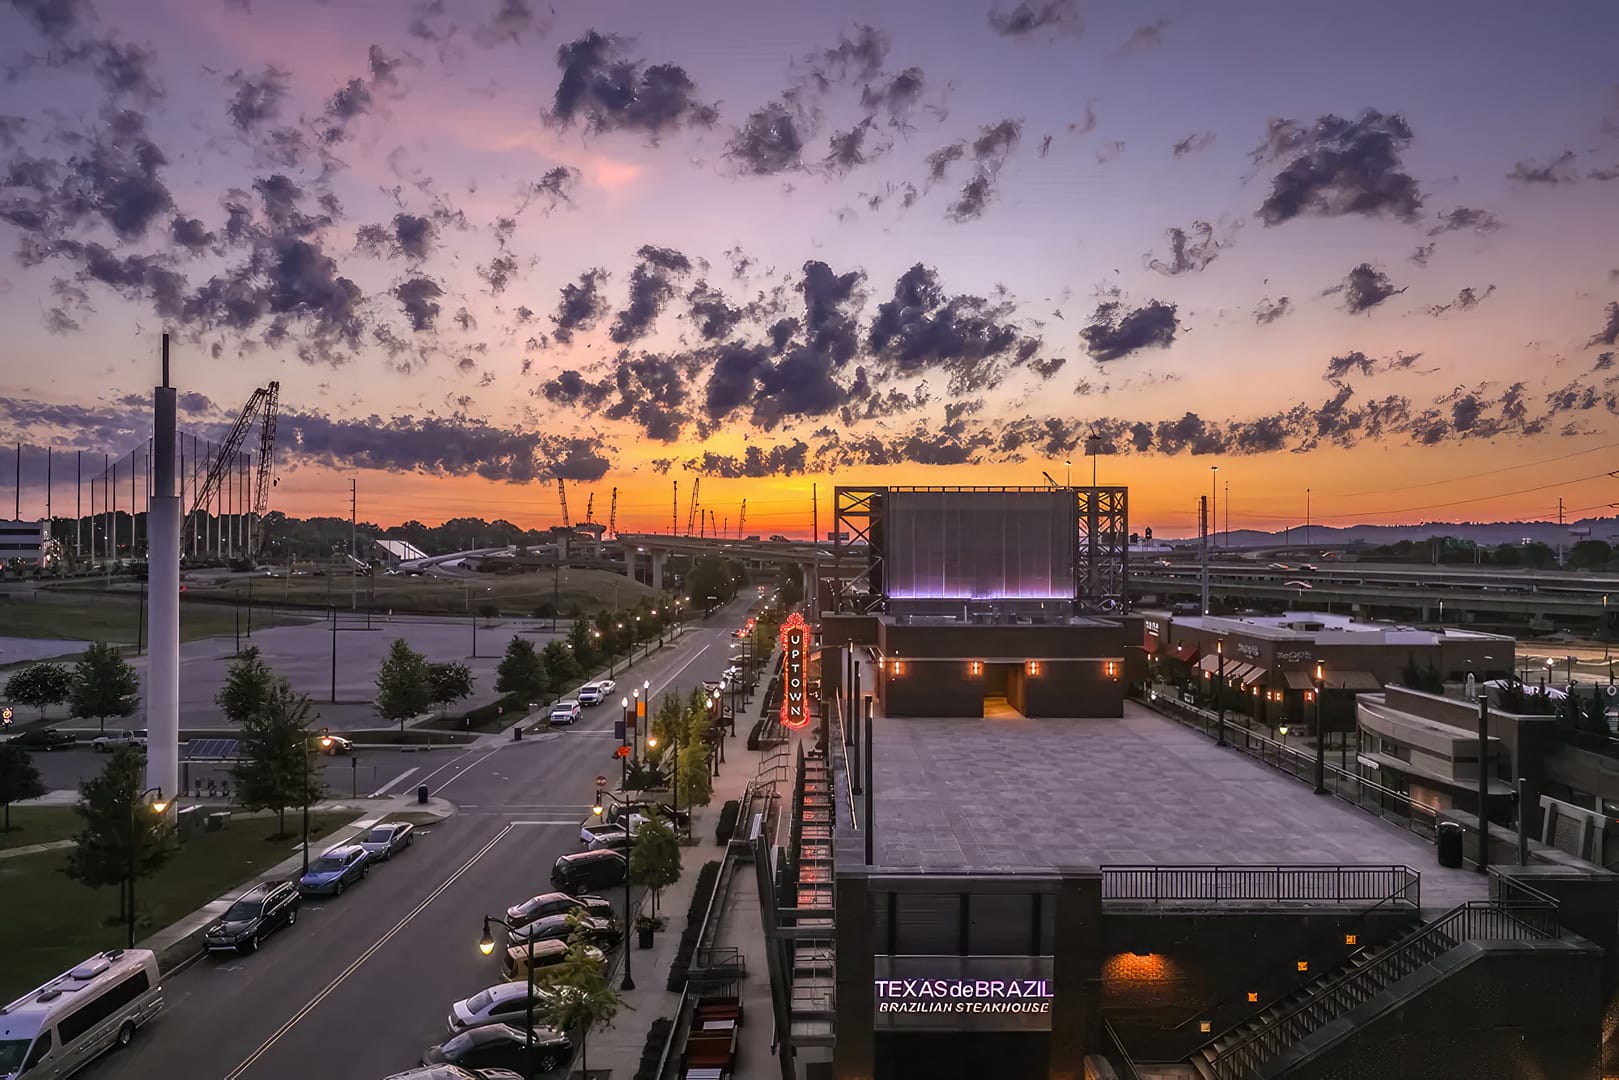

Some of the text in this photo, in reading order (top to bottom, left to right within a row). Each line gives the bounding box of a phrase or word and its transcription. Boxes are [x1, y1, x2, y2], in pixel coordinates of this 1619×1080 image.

[789, 635, 802, 716] UPTOWN
[879, 1002, 1049, 1013] BRAZILIAN STEAKHOUSE
